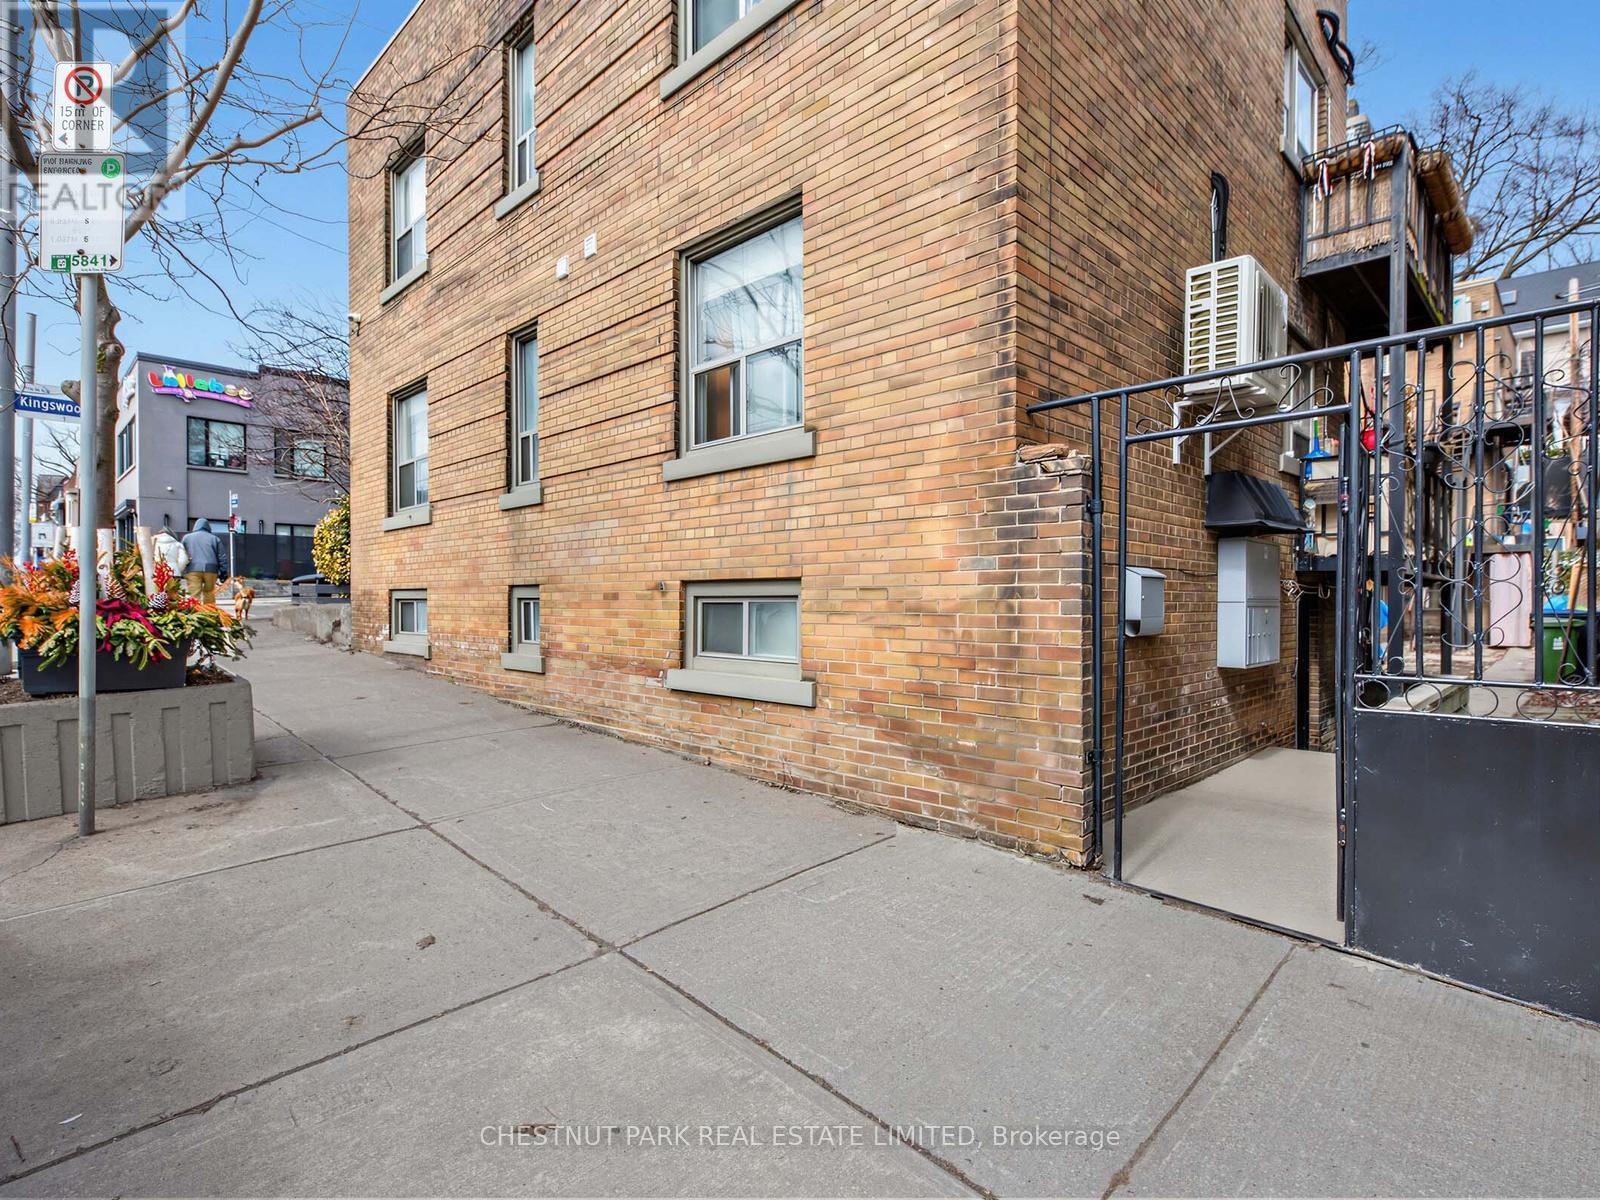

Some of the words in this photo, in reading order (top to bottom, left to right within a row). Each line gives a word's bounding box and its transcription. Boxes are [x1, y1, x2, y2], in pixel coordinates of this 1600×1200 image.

[92, 106, 107, 117] OF
[61, 120, 105, 131] CORNER
[105, 163, 117, 175] P
[71, 255, 107, 267] 5841
